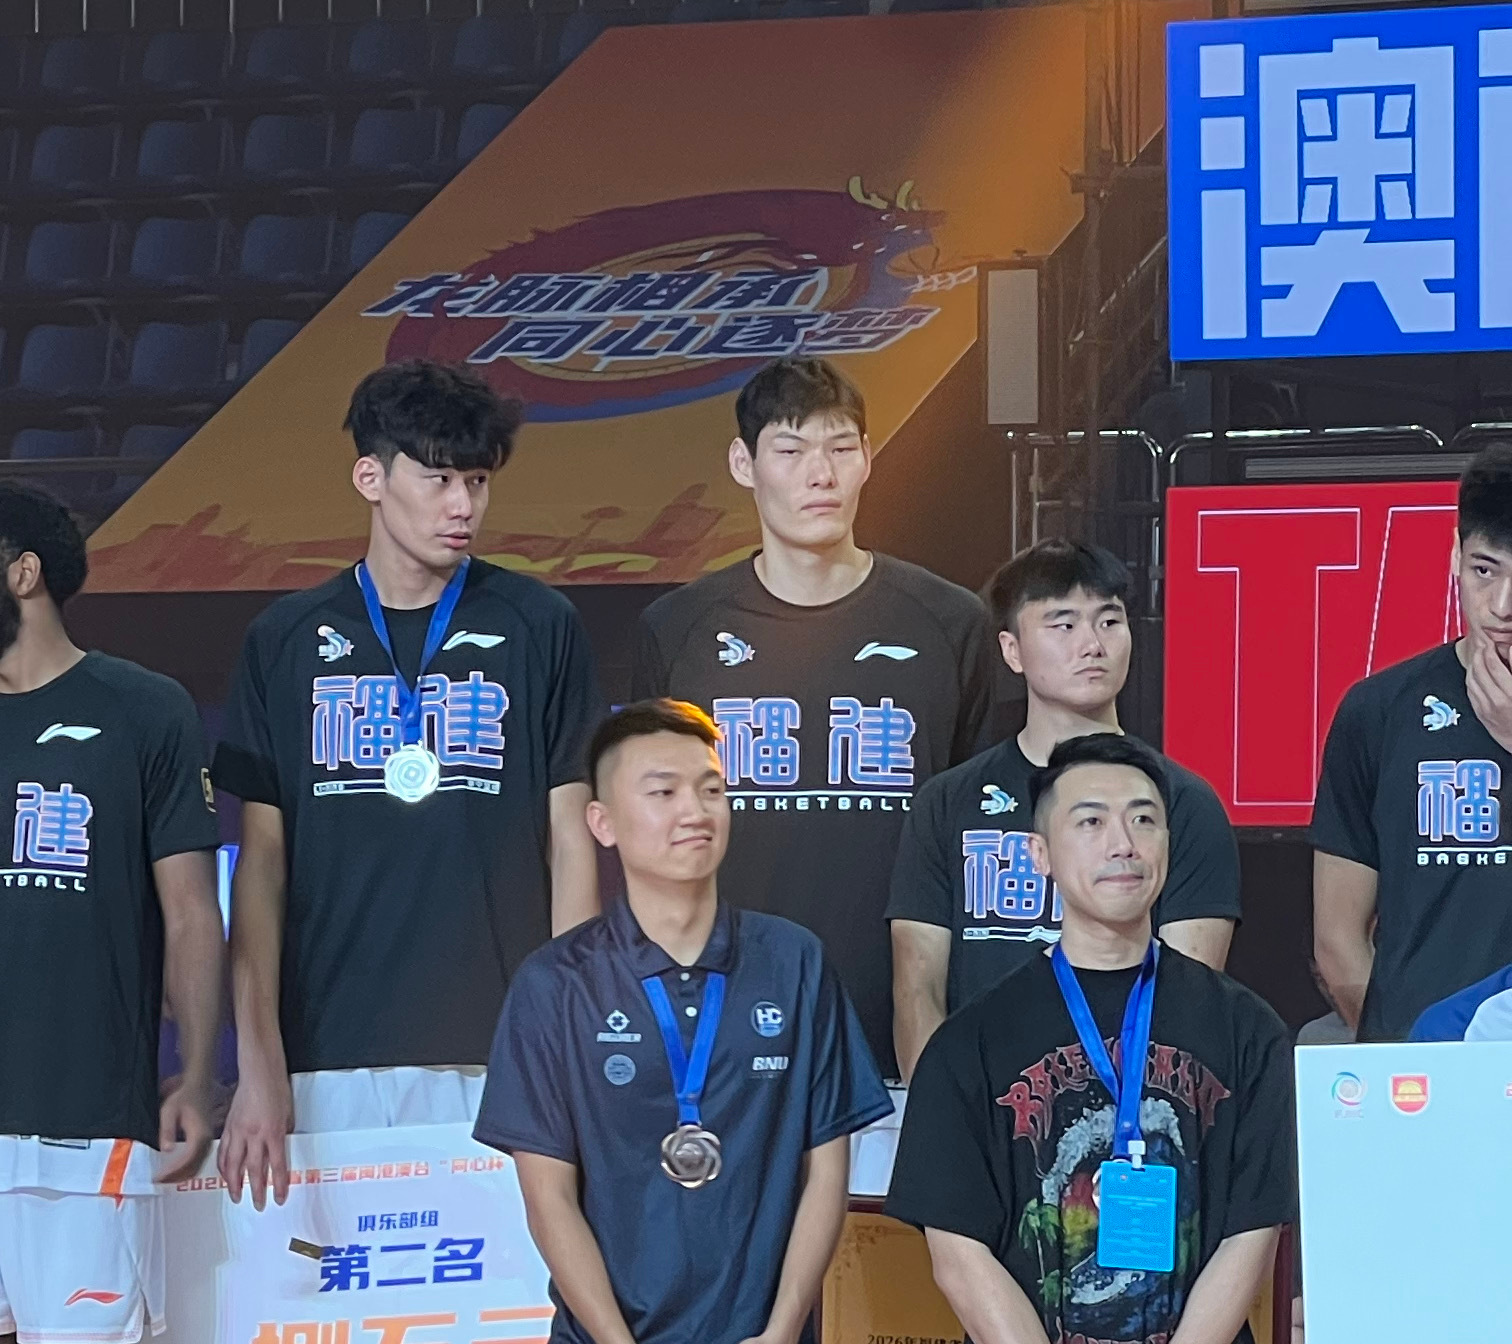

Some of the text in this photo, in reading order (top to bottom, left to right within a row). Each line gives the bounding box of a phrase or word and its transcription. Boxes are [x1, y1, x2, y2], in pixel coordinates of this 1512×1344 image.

[1199, 28, 1512, 340] 澳
[361, 266, 829, 318] 龙脉相承
[467, 307, 942, 371] 同心逐梦
[311, 670, 510, 771] 福建
[712, 696, 916, 786] 福建
[732, 796, 911, 812] ASKETBALL
[357, 1210, 439, 1233] 俱乐部组
[318, 1237, 485, 1293] 第二名
